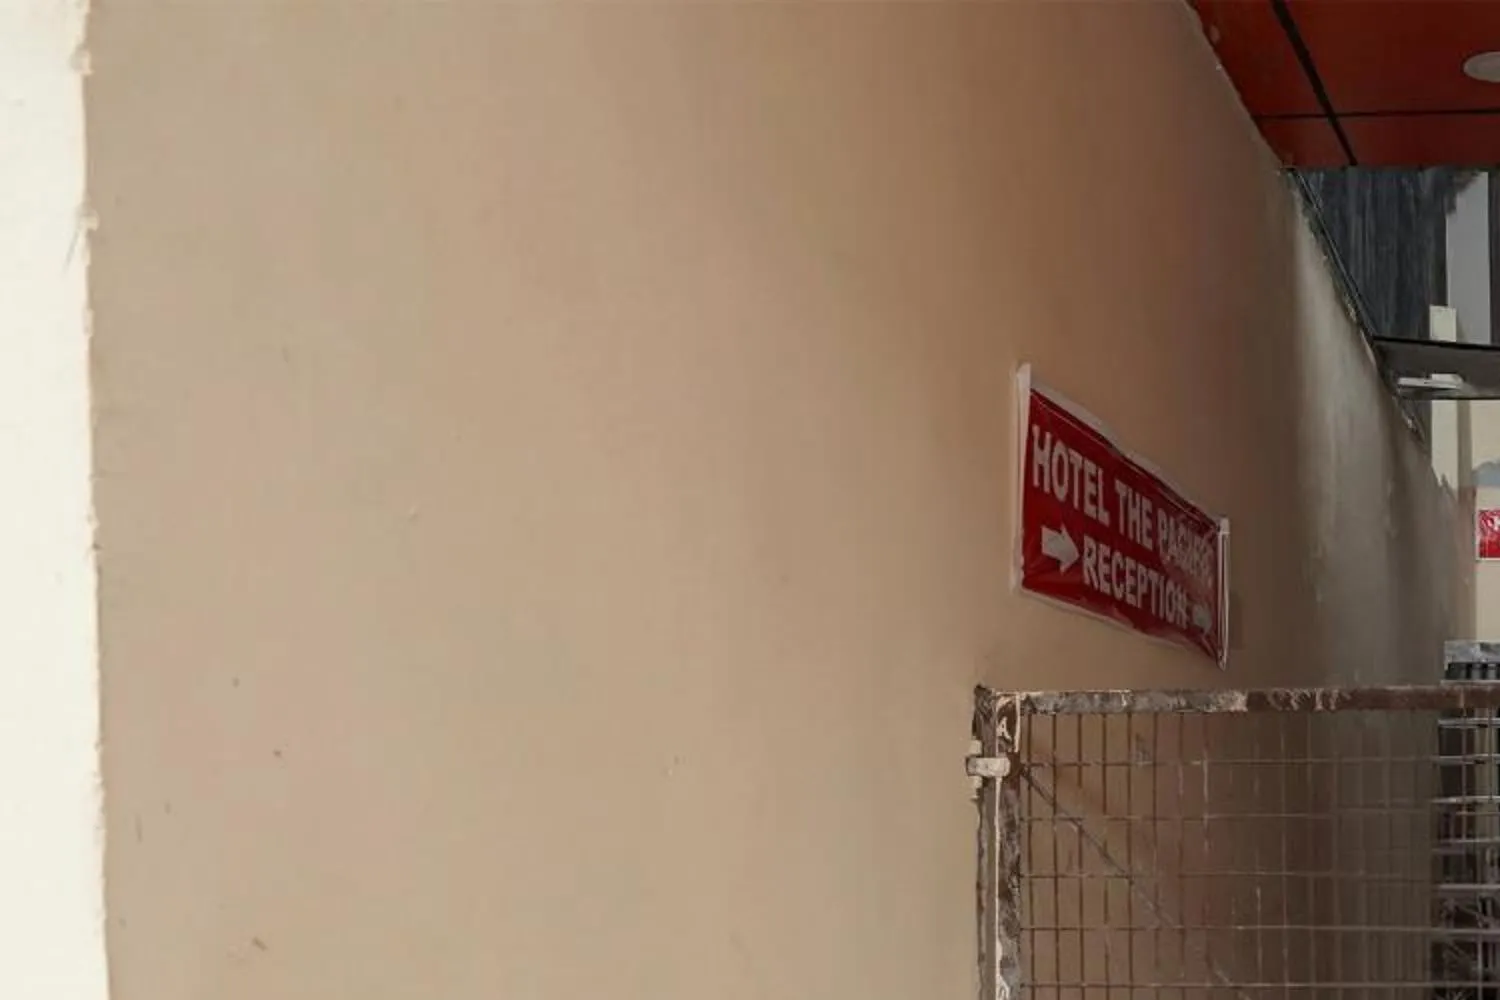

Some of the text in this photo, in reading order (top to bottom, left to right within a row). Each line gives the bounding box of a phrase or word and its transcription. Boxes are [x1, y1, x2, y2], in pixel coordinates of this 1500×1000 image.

[1031, 424, 1110, 527] HOTEL
[1114, 479, 1154, 551] THE
[1083, 532, 1188, 630] RECEPTION
